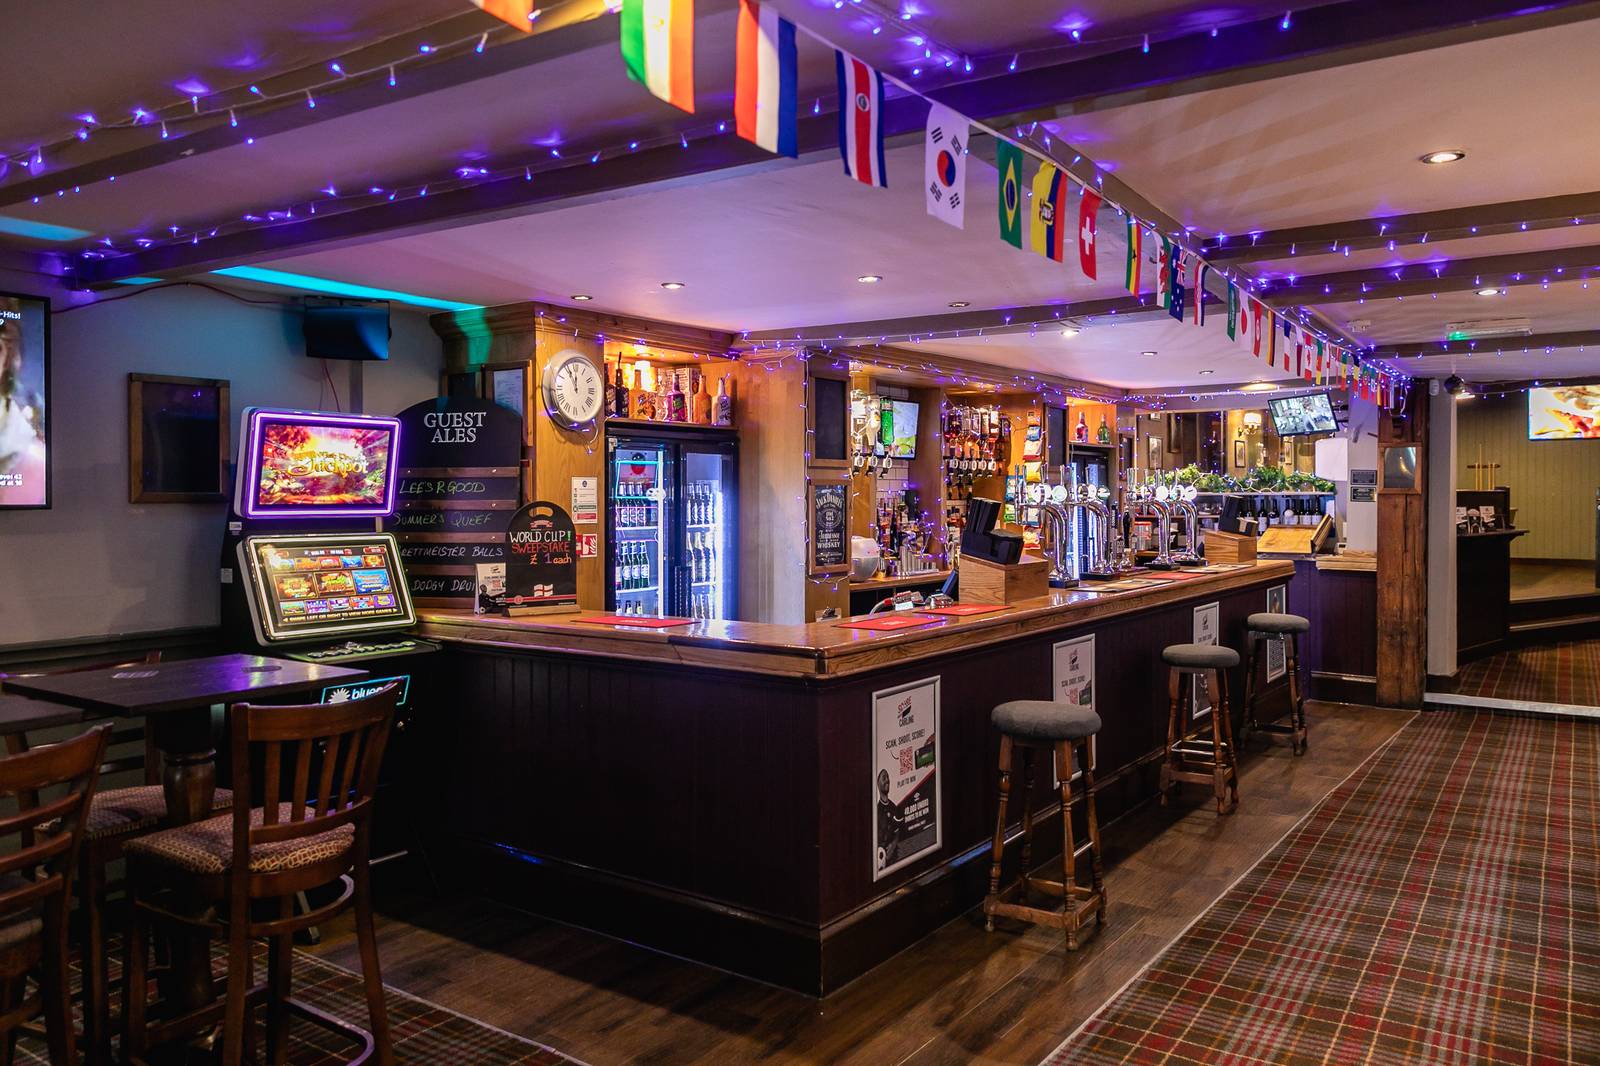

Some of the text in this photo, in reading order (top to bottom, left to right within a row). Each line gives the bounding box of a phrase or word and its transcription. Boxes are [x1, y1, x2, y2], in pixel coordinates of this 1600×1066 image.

[0, 311, 21, 320] -Hits!
[424, 412, 486, 428] GUEST
[431, 428, 477, 443] ALES
[447, 480, 486, 495] GOOD
[509, 531, 542, 543] WORLD
[471, 546, 504, 557] BALLS
[512, 541, 570, 554] SWEEPSTAKE
[553, 553, 572, 564] each
[411, 579, 445, 592] DODGY
